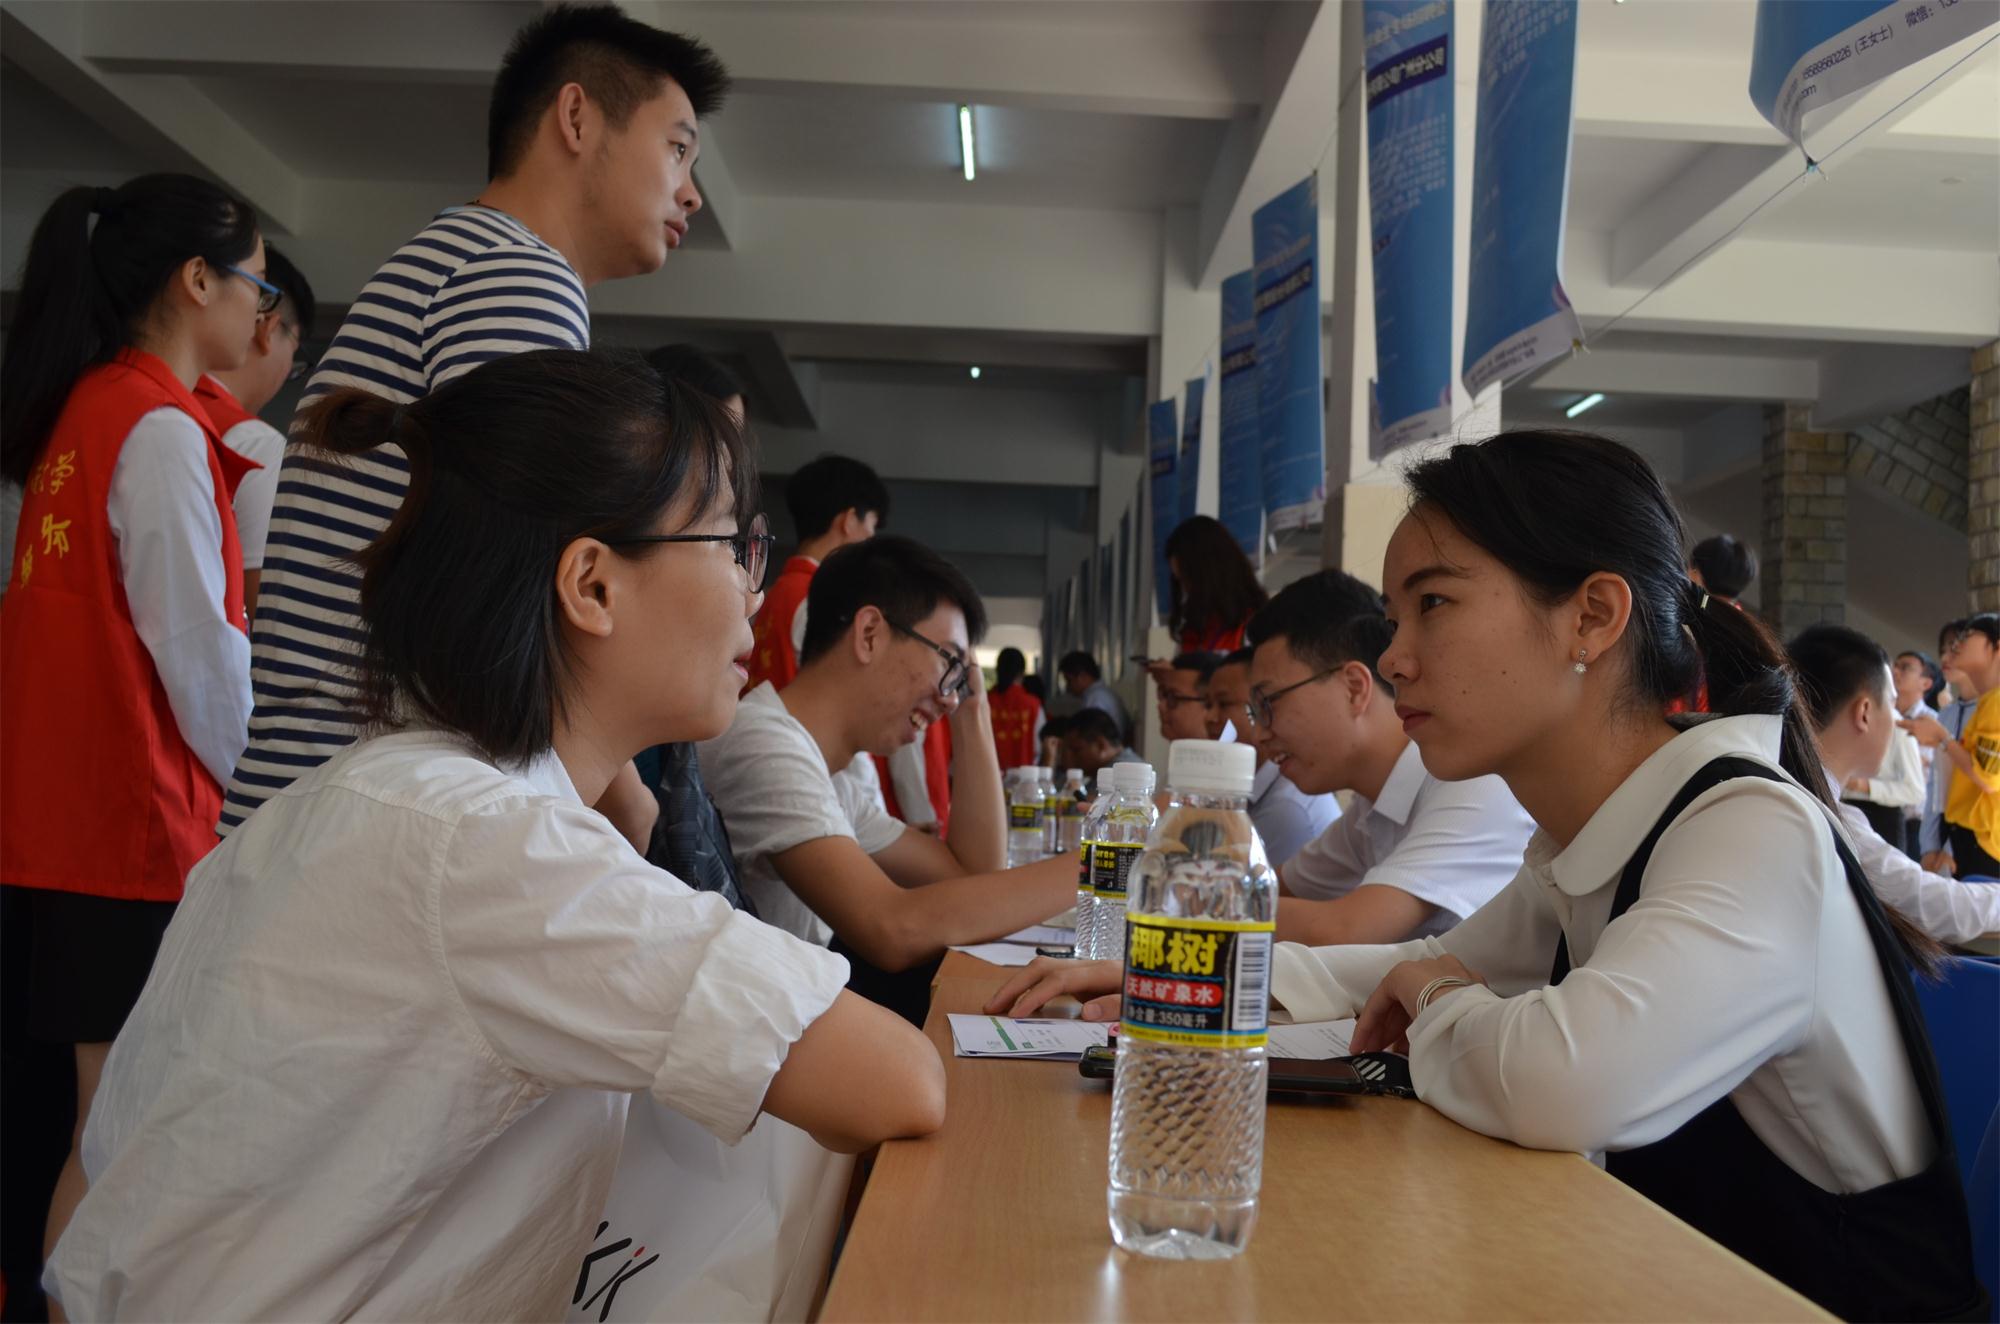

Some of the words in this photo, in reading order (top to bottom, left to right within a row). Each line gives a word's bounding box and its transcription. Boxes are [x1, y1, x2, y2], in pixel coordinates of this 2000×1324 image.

[1130, 926, 1218, 975] 椰树
[1127, 976, 1214, 1004] 天然矿泉水
